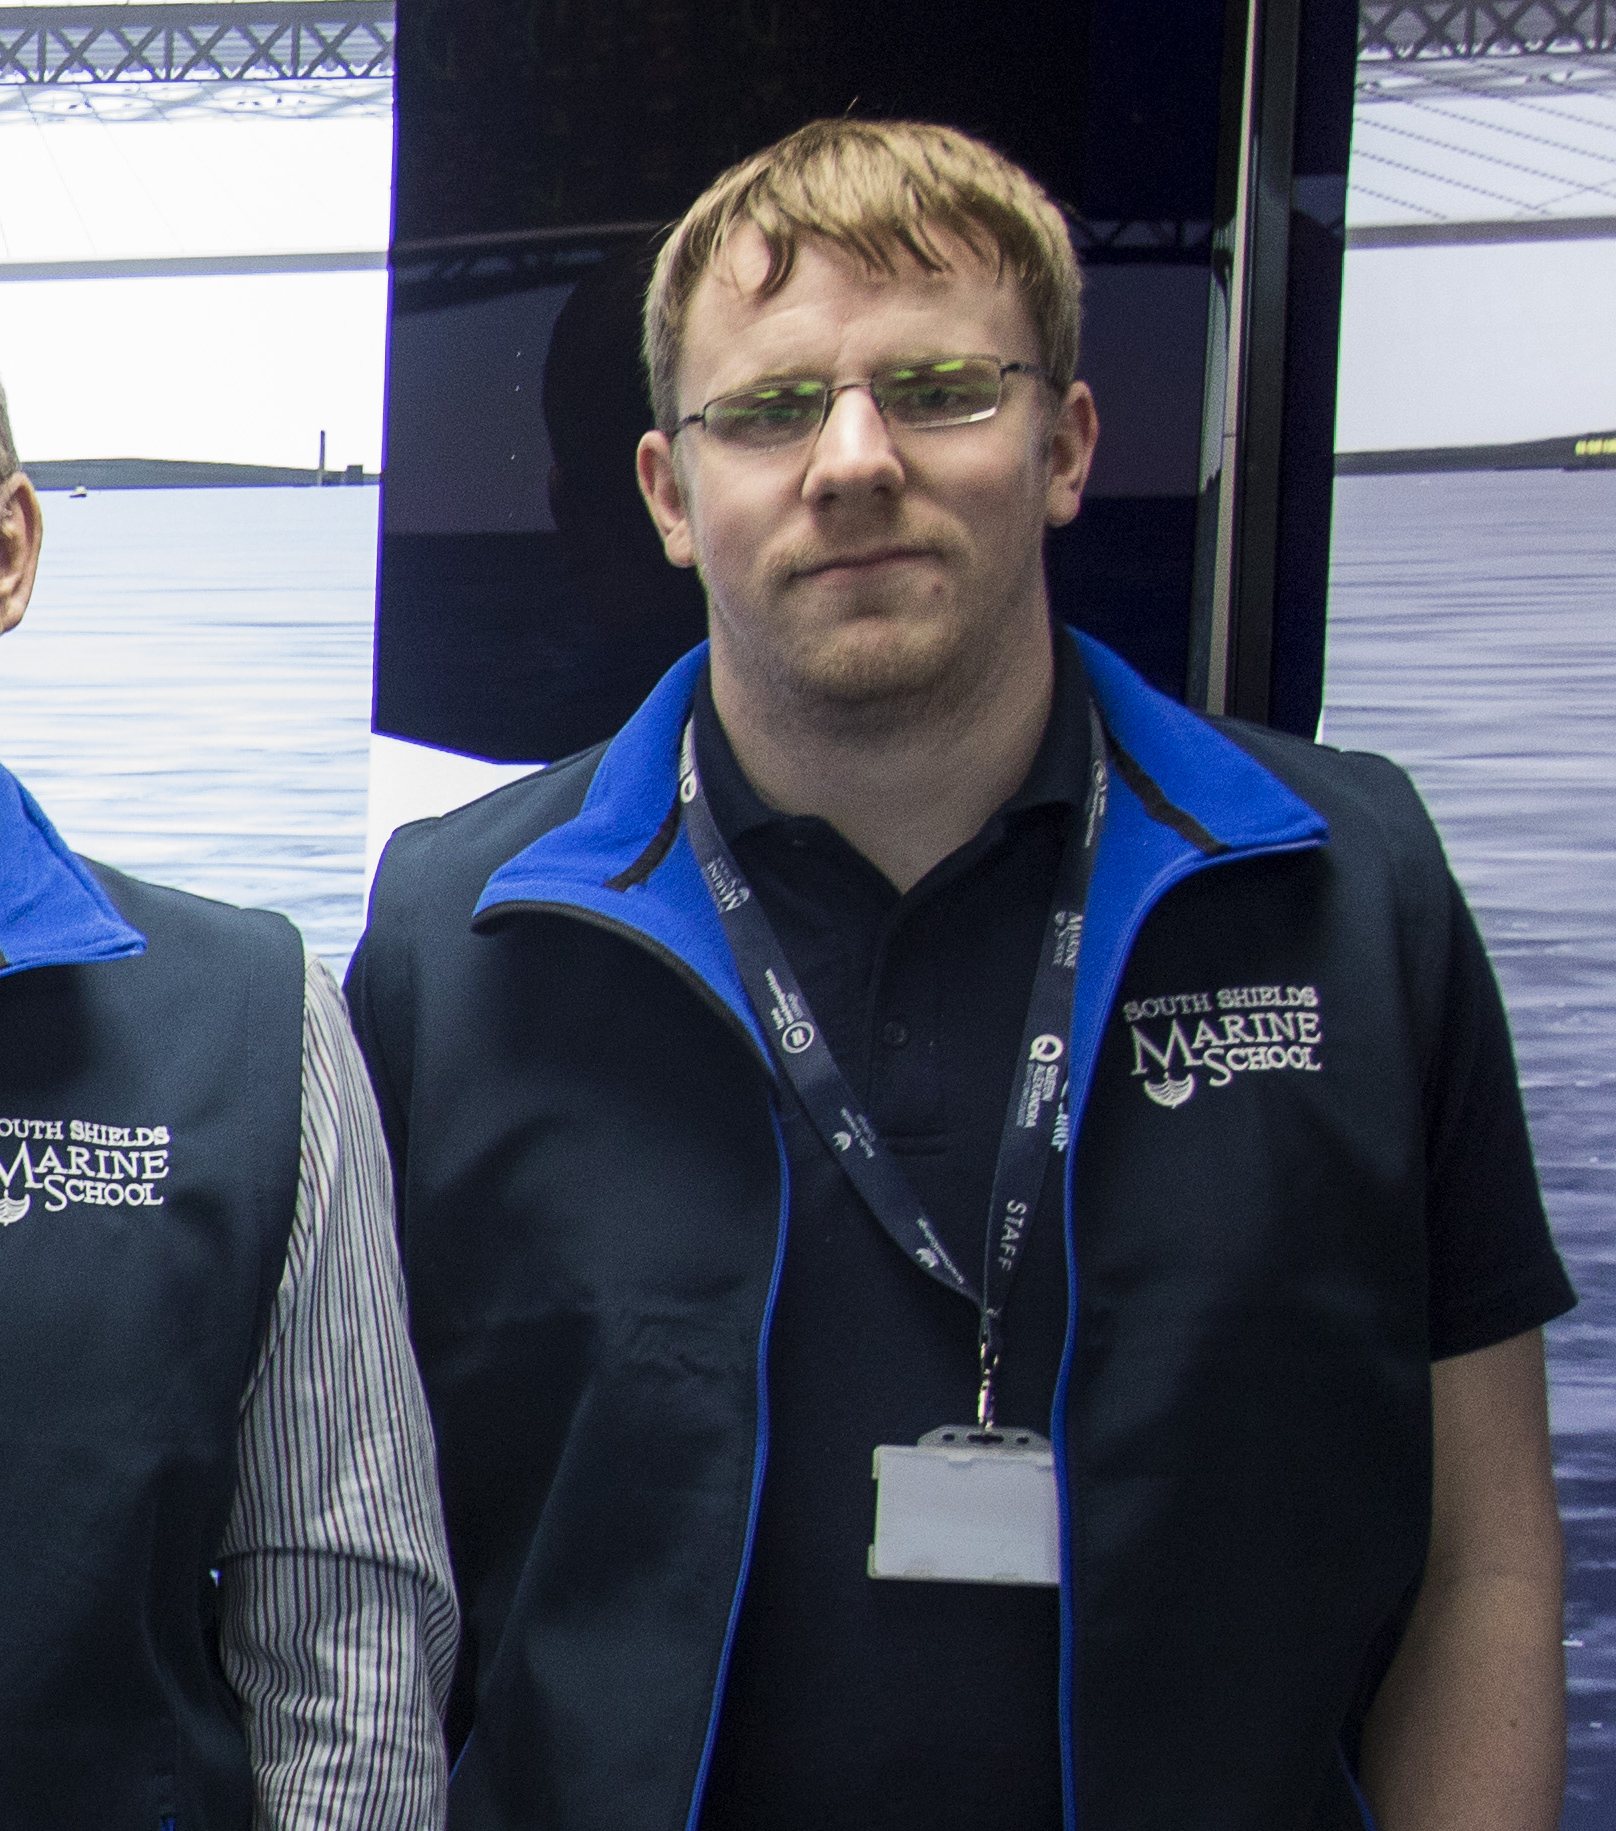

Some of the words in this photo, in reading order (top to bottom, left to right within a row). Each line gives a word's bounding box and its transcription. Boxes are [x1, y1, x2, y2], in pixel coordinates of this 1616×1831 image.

[1123, 993, 1213, 1022] SOUTH
[1216, 985, 1319, 1009] SHIELDS
[1130, 1011, 1322, 1076] MARINE
[1202, 1045, 1323, 1087] SCHOOL
[69, 1119, 171, 1148] SHIELDS
[43, 1174, 164, 1212] SCHOOL
[998, 1199, 1027, 1272] STAFF
